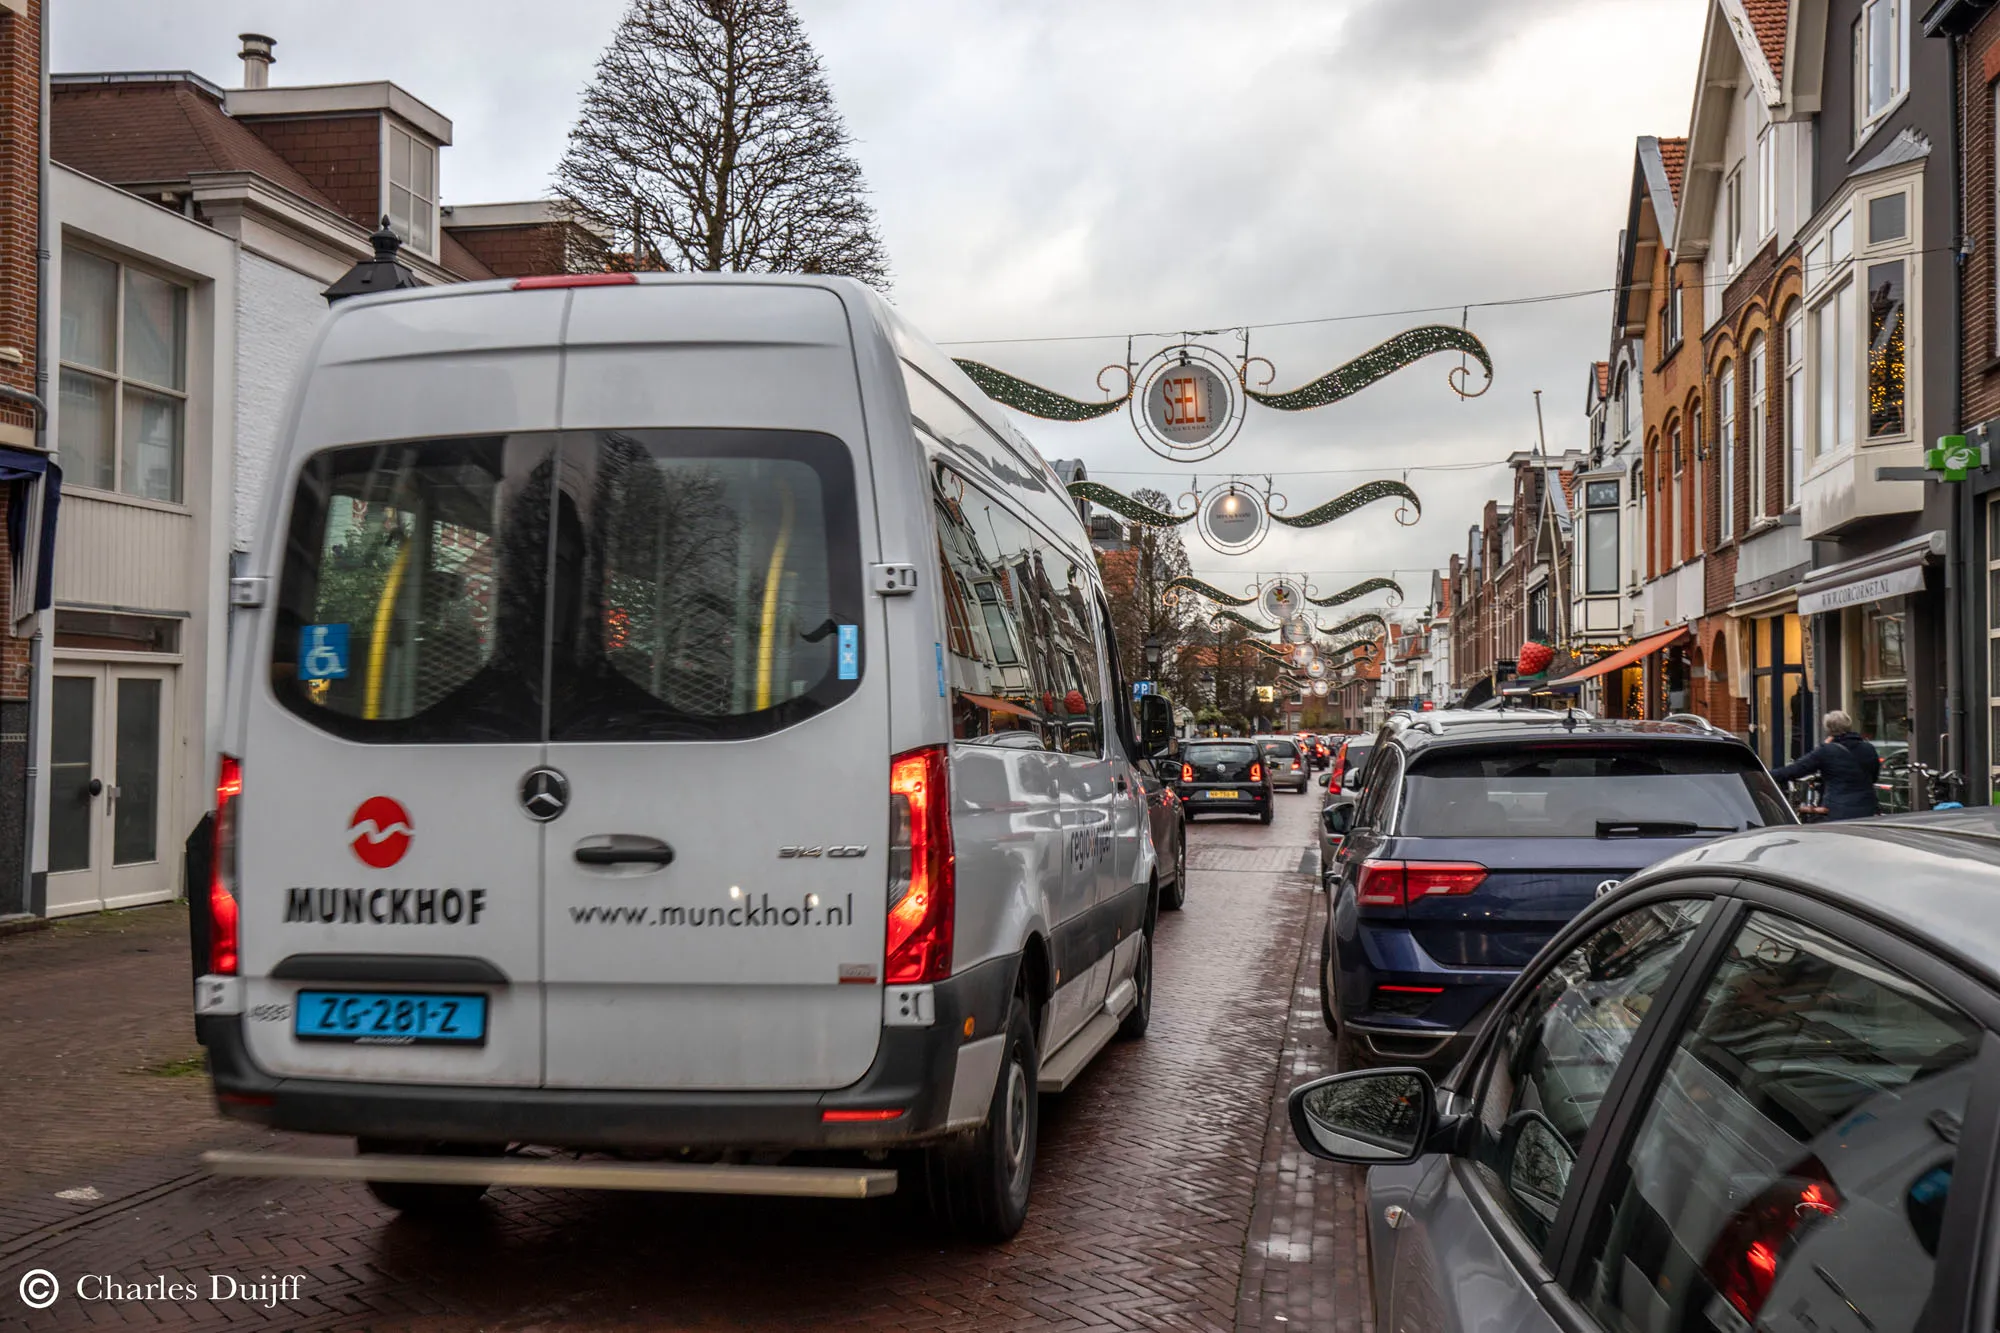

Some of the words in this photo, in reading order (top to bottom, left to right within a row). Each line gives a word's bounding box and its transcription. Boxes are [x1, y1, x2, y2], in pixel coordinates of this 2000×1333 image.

[1821, 579, 1890, 607] WWW.CORCORNET.NL
[826, 843, 869, 858] CDI
[285, 887, 487, 925] MUNCKHOF
[569, 893, 853, 928] www.munckhof.nl
[318, 996, 461, 1034] ZG-281-Z
